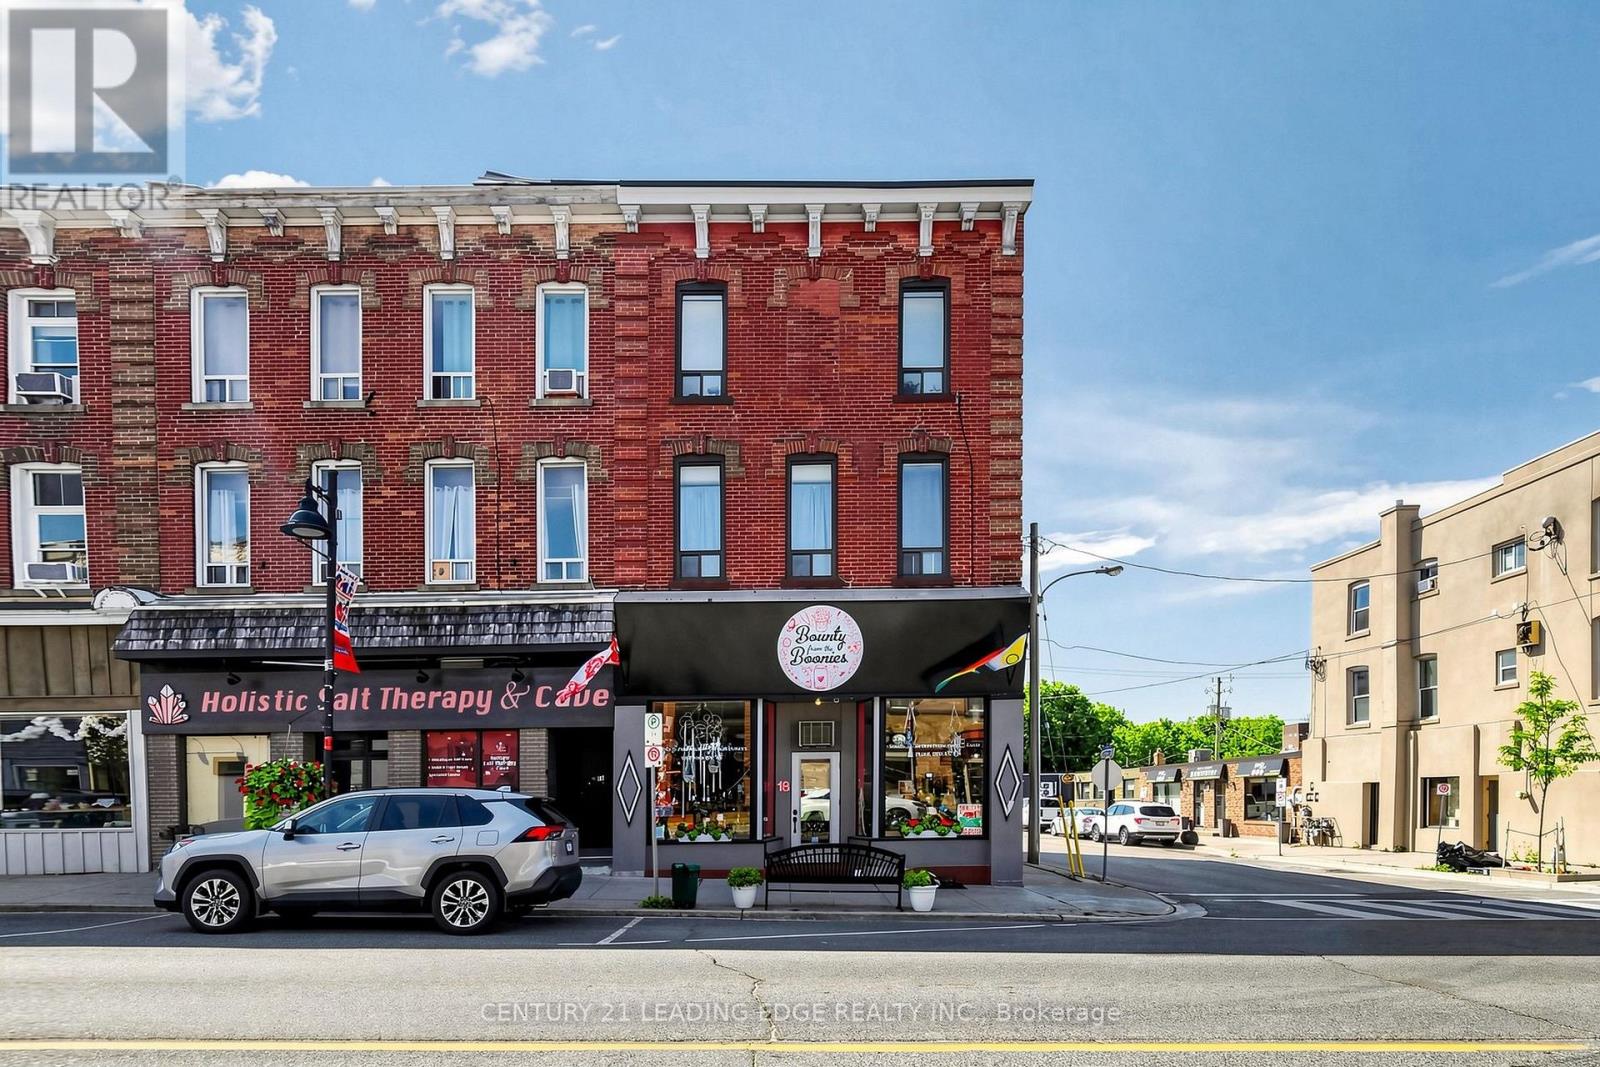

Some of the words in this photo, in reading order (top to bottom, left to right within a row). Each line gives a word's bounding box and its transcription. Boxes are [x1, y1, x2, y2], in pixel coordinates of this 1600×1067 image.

[795, 625, 847, 651] Bounty
[789, 646, 849, 667] Boonies
[201, 690, 309, 713] Holistic
[379, 686, 494, 716] Therapy
[500, 680, 531, 710] &
